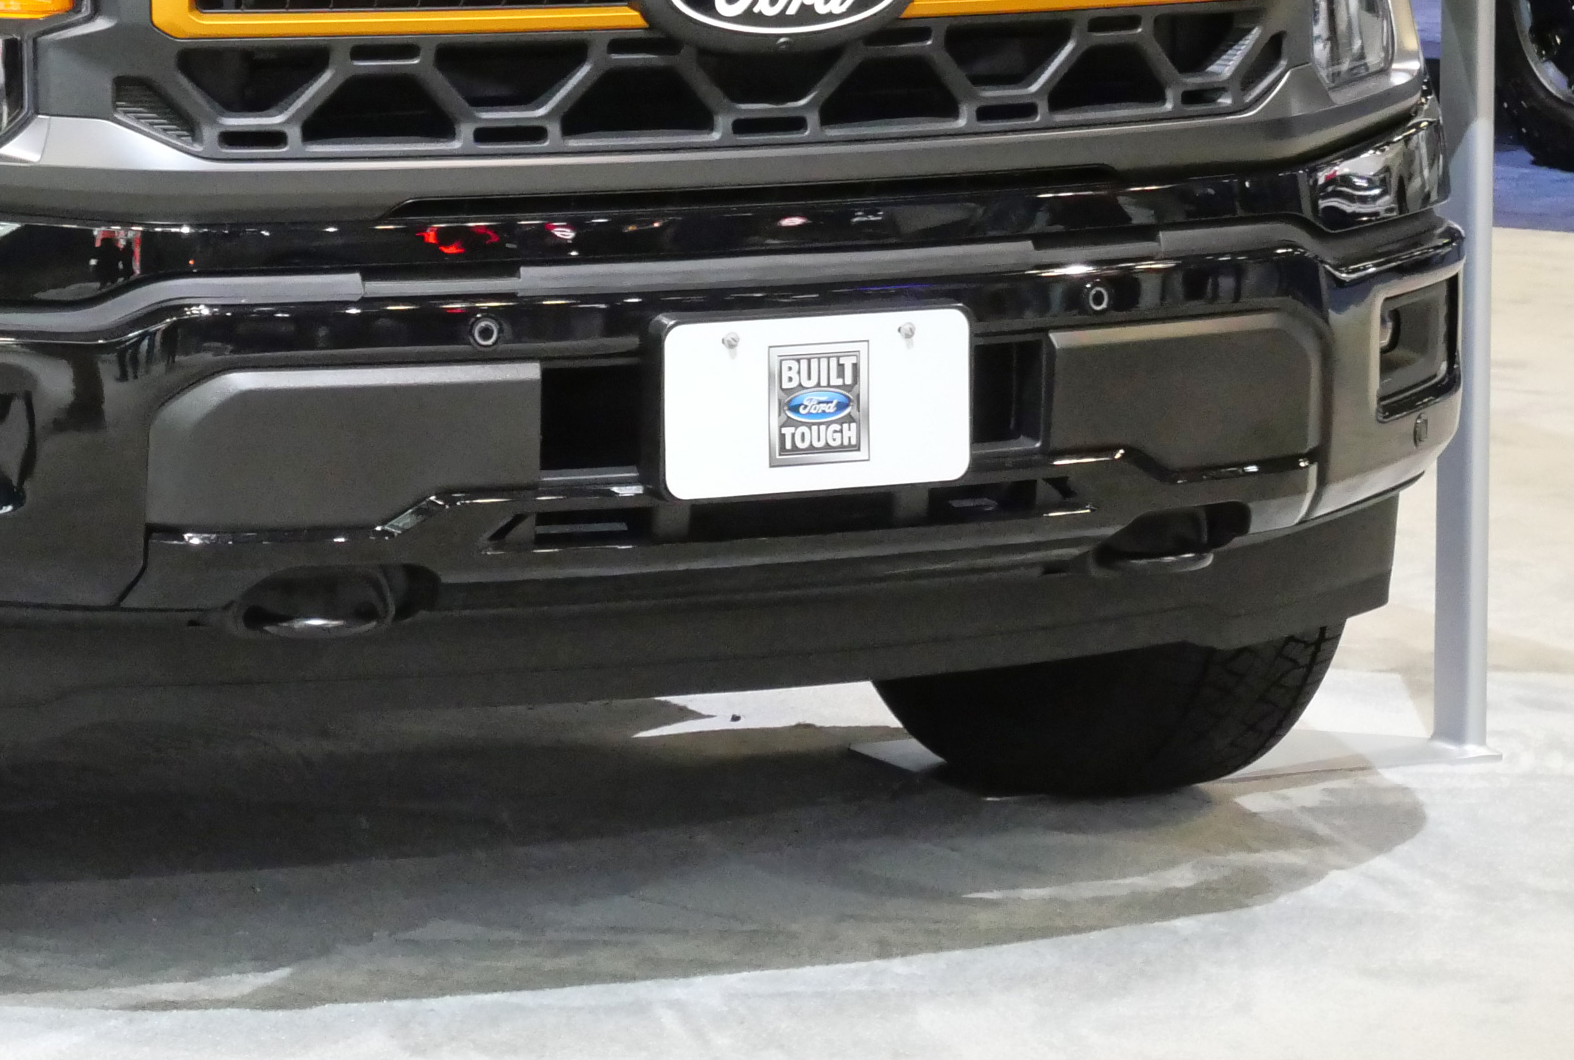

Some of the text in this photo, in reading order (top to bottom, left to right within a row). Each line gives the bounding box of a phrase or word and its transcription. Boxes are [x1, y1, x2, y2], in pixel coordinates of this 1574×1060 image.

[782, 356, 857, 389] BUILT
[799, 396, 837, 414] Ford
[782, 423, 857, 450] TOUGH
